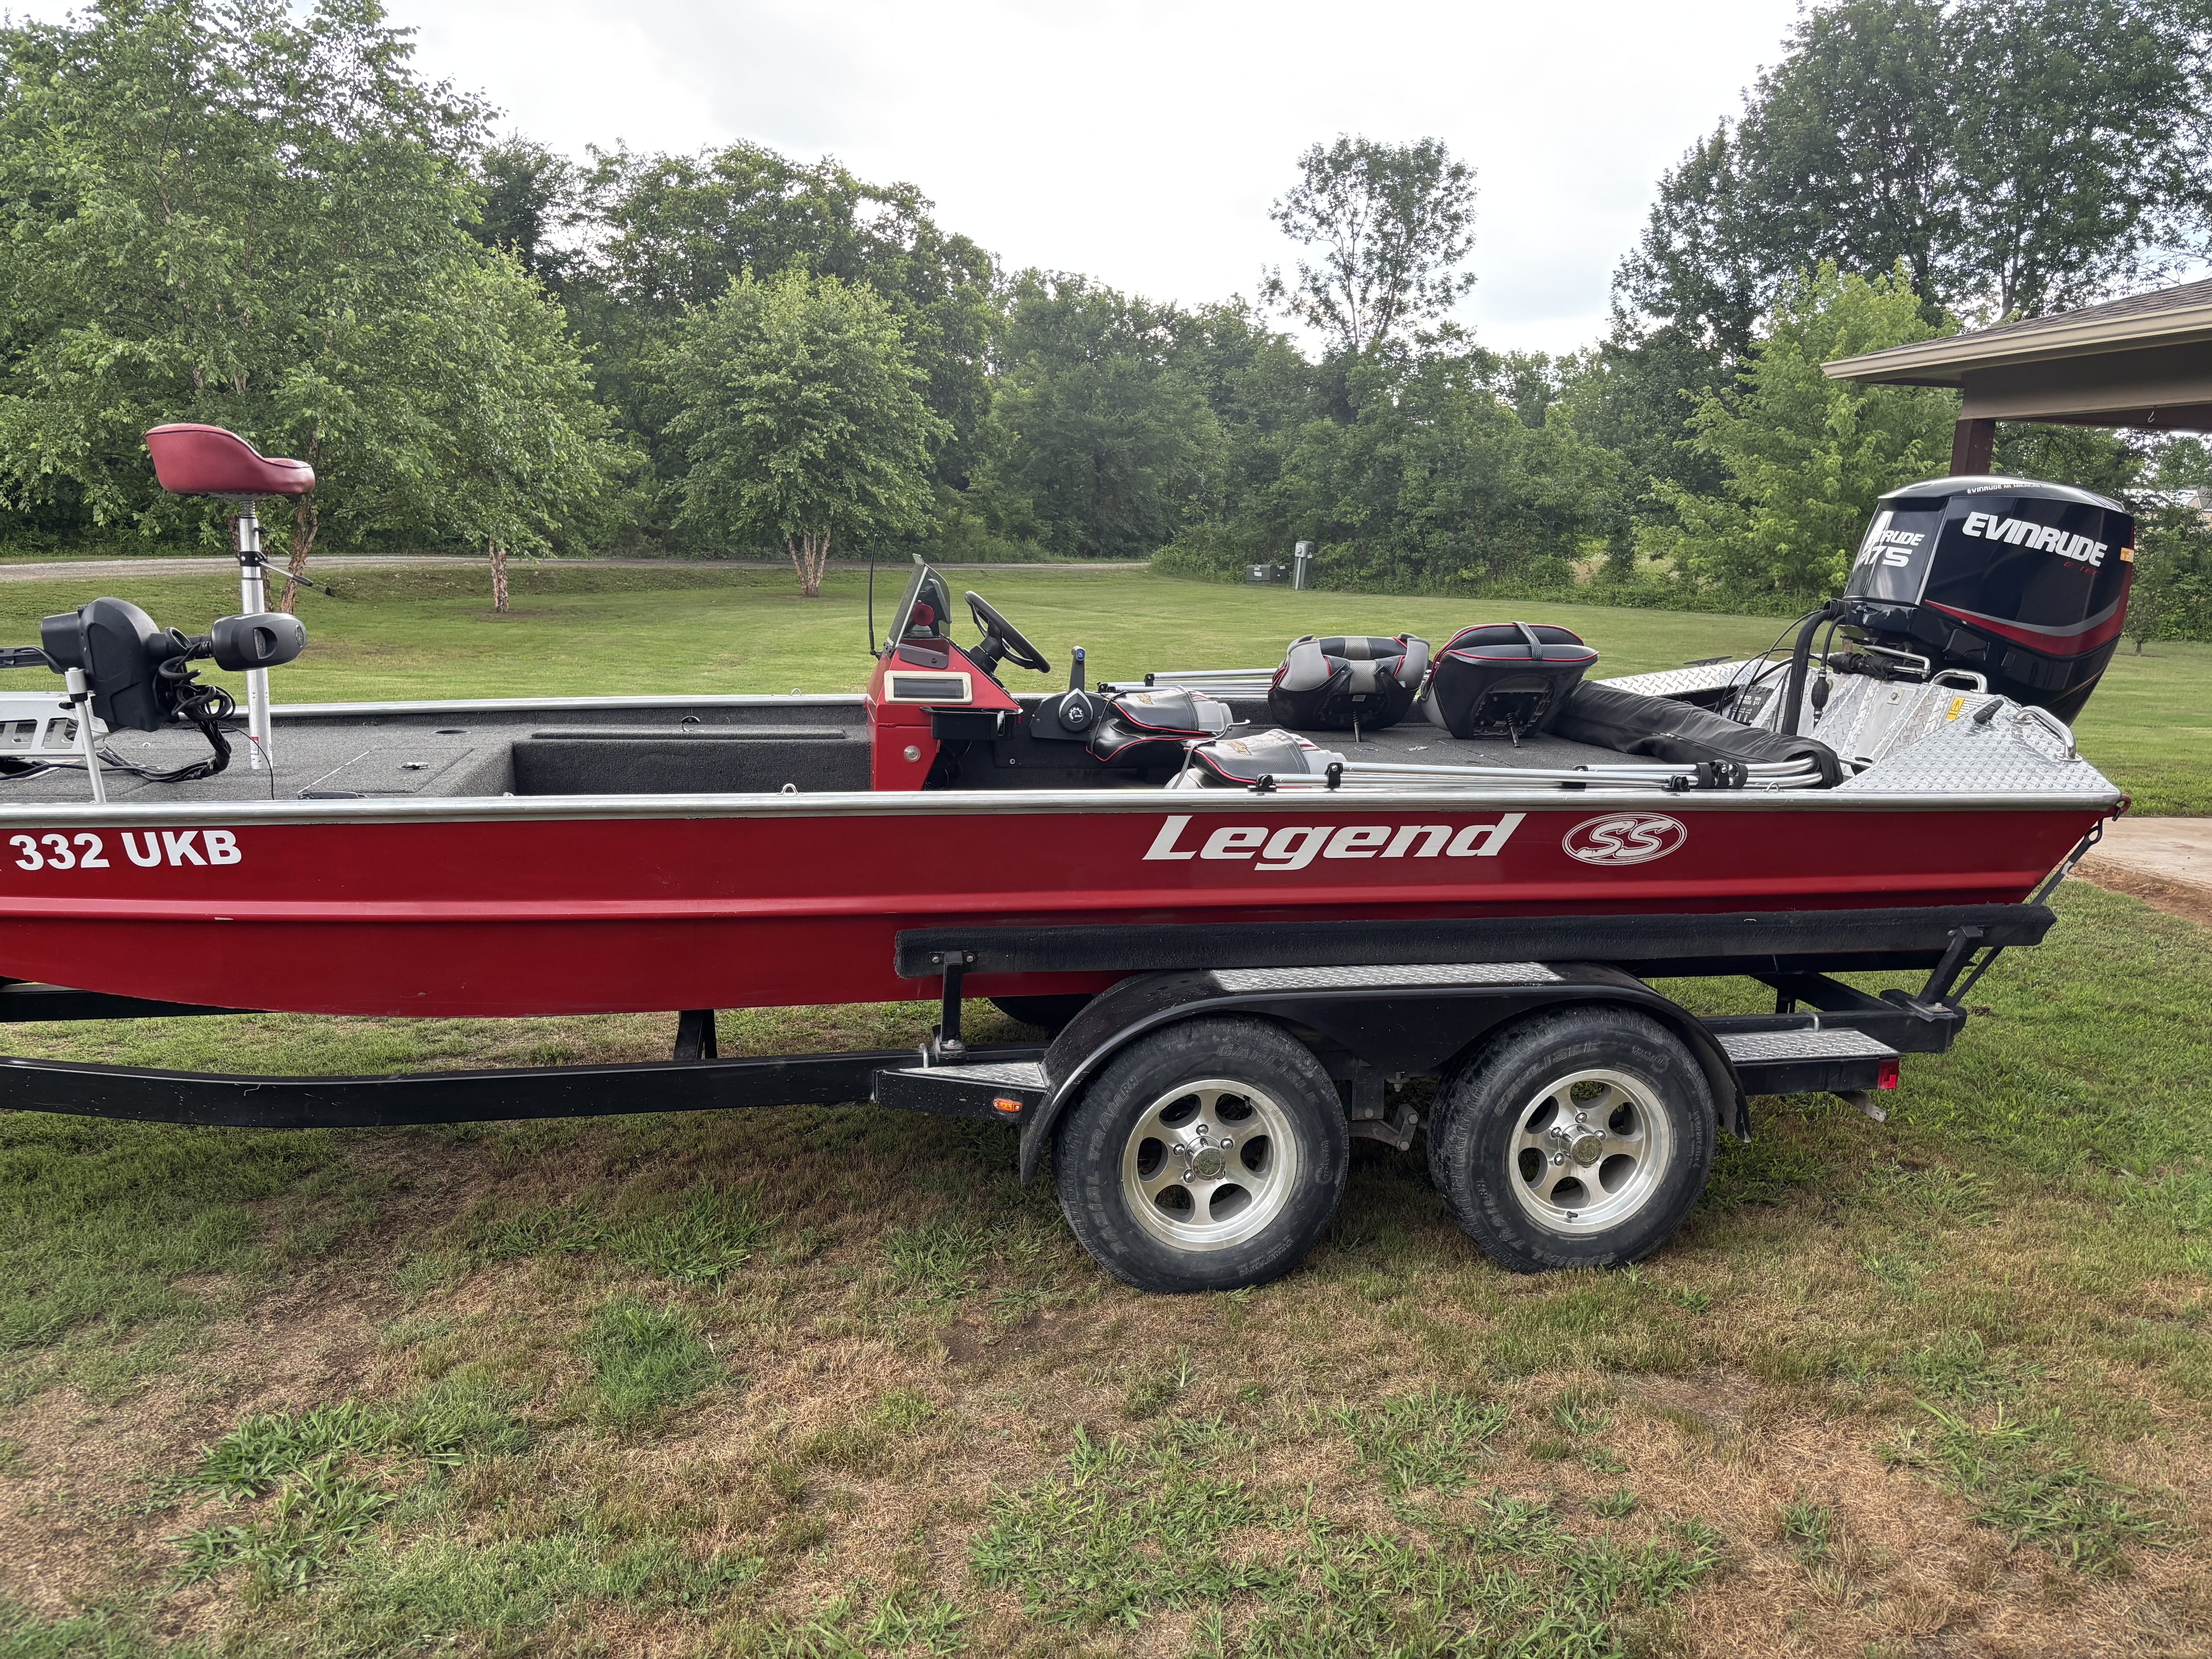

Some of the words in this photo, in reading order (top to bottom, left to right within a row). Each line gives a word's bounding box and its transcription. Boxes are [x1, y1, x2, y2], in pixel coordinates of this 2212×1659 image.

[1967, 484, 2002, 494] EVINRUDE
[1962, 512, 2108, 567] EVINRUDE
[9, 833, 110, 871] 332
[121, 830, 242, 867] UKB
[1142, 813, 1527, 871] Legend
[1575, 818, 1677, 859] SS
[1217, 1044, 1320, 1107] CARLISLE
[1494, 1039, 1599, 1117] CARLISLE
[1087, 1094, 1130, 1161] TRAIL
[1087, 1170, 1130, 1256] RADIAL
[1484, 1194, 1525, 1250] TRAIL
